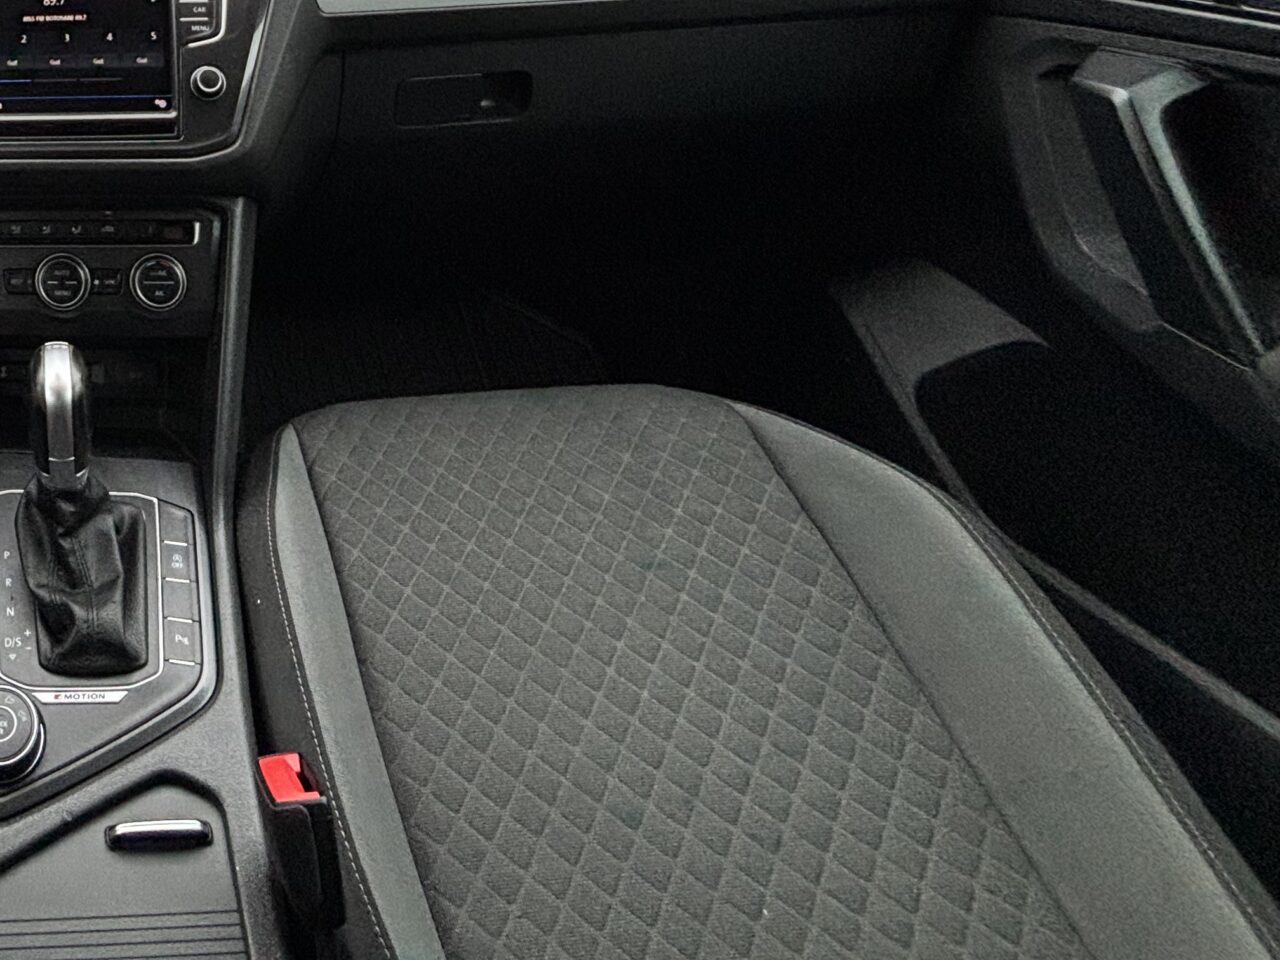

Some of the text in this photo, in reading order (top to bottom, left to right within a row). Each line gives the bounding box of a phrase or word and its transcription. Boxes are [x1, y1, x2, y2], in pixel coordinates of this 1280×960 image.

[21, 34, 28, 44] 2
[64, 33, 70, 43] 3
[106, 32, 114, 42] 4
[150, 31, 157, 41] 5
[3, 550, 11, 560] P
[5, 577, 13, 587] R
[6, 606, 16, 617] N
[4, 637, 22, 648] D/S
